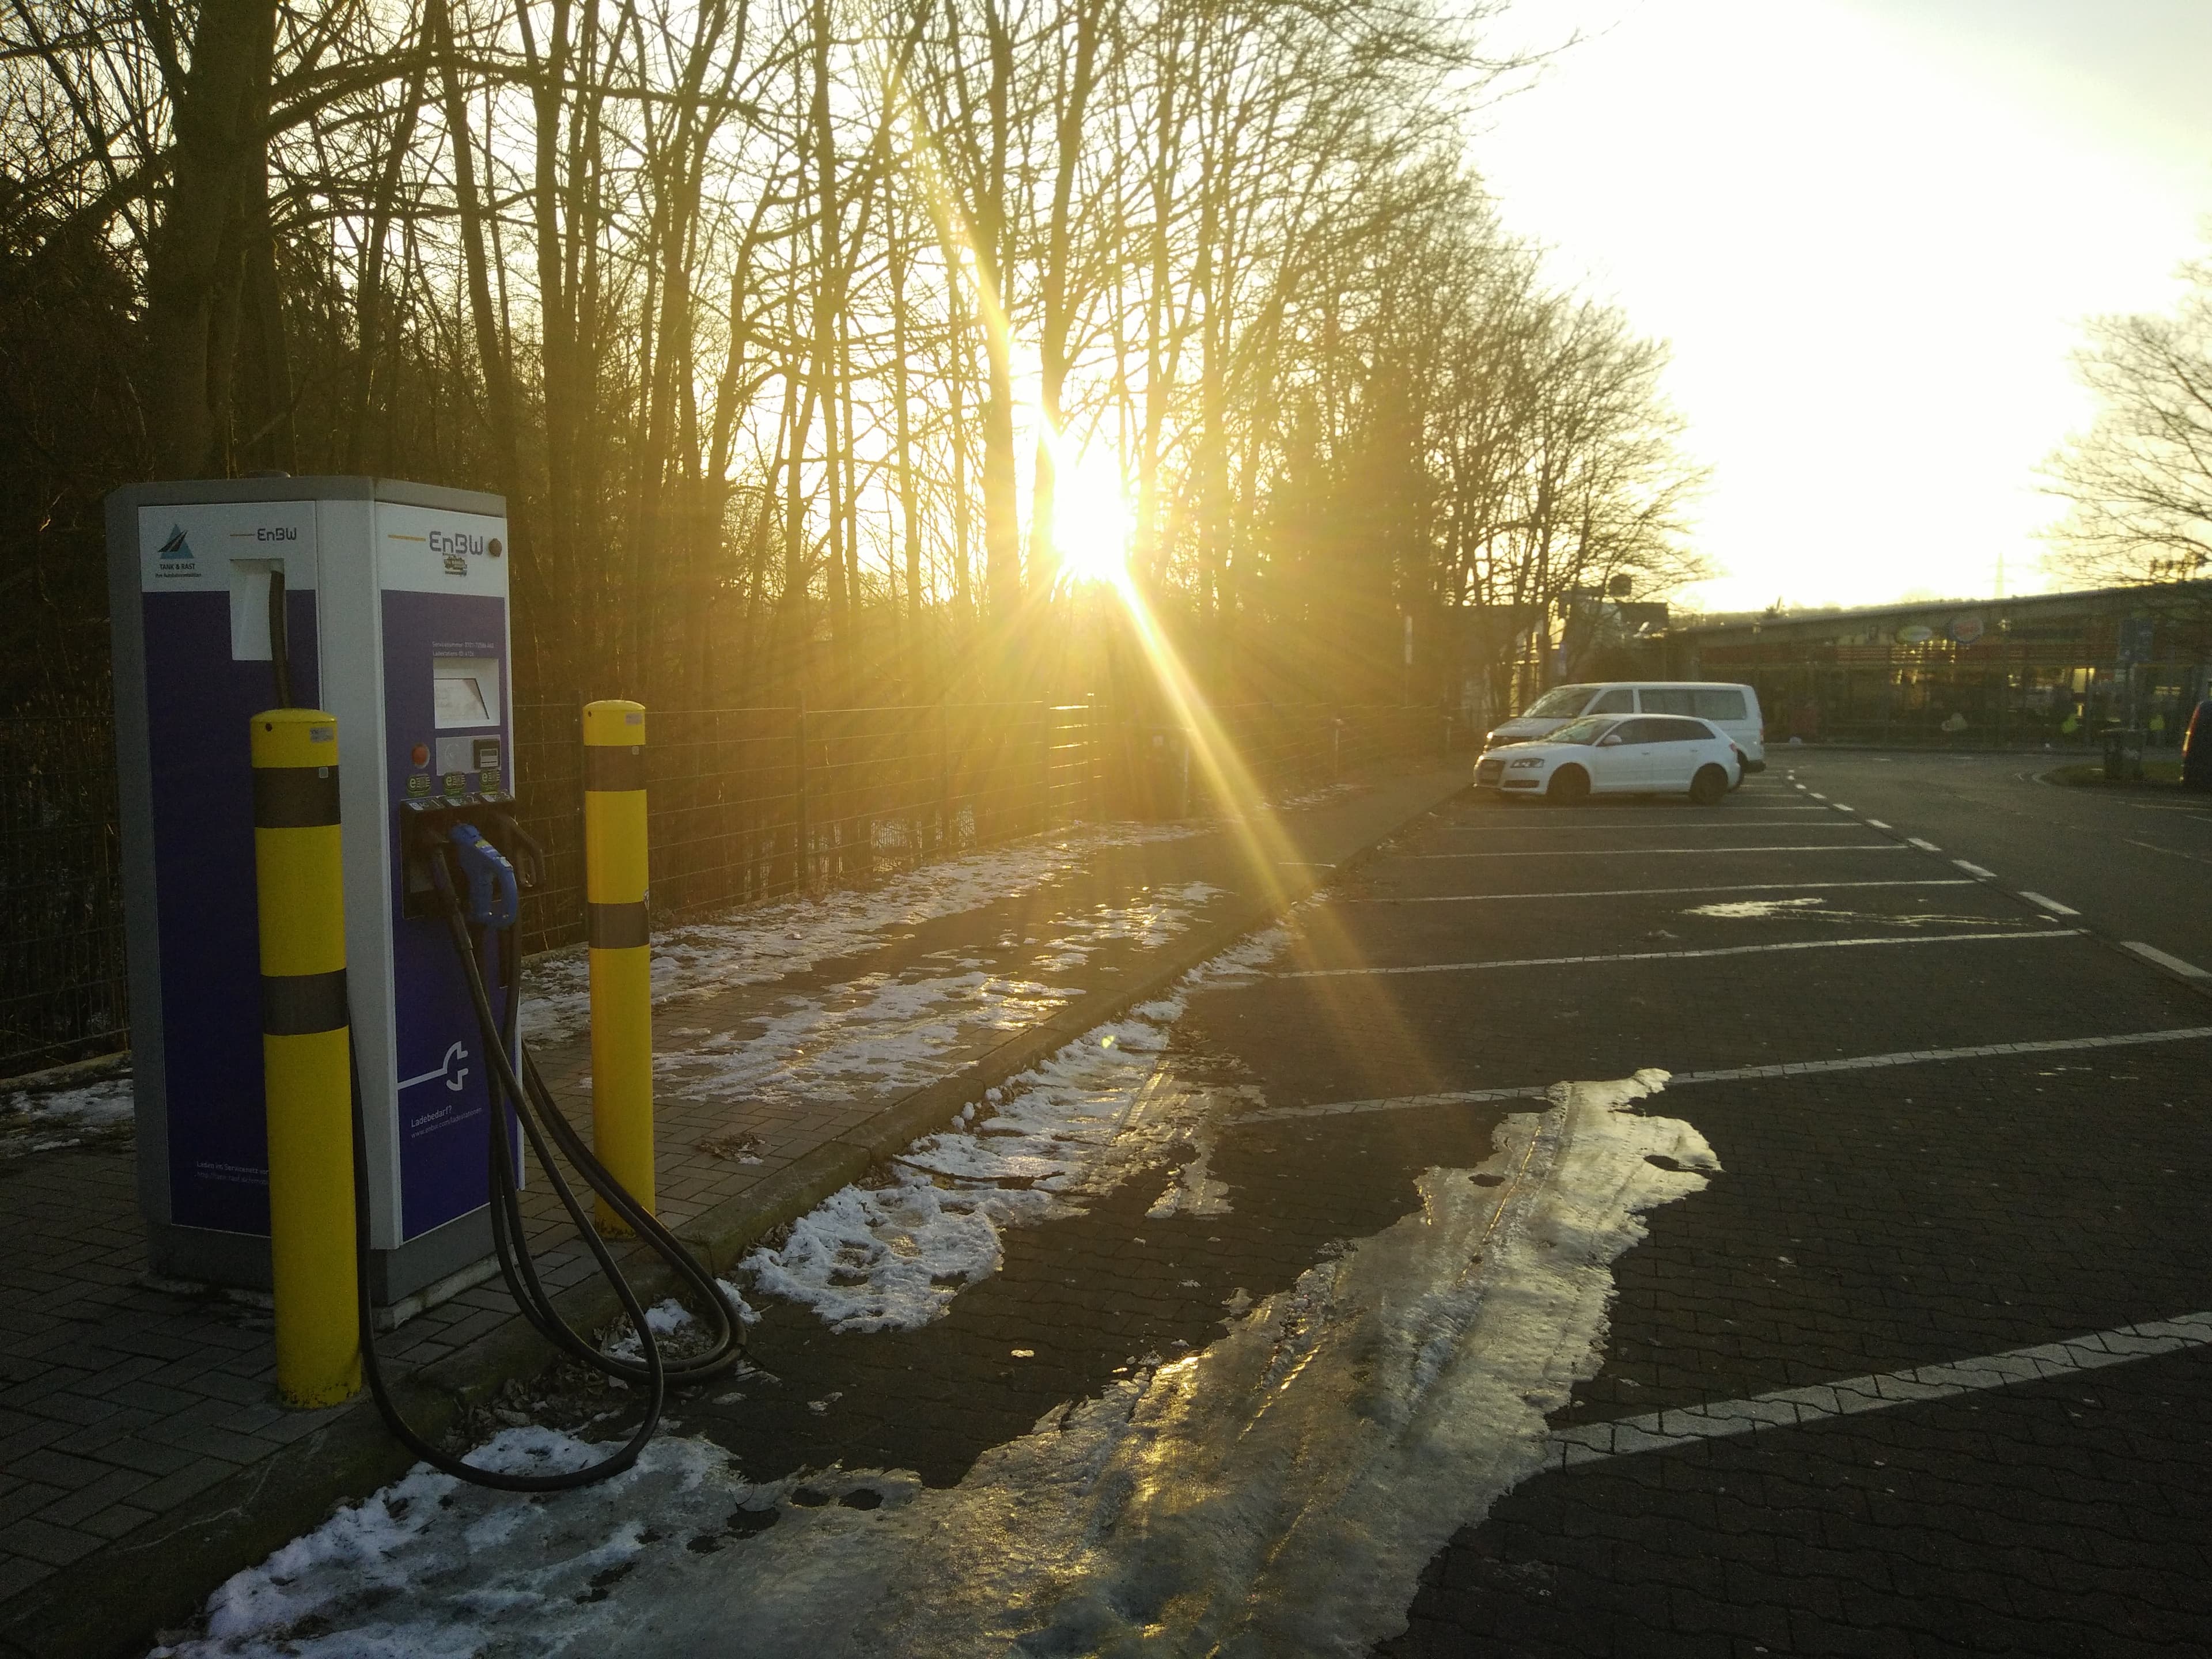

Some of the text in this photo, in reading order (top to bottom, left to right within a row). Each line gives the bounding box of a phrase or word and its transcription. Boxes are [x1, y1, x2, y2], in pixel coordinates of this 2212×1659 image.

[257, 527, 297, 541] EnBW
[429, 531, 483, 555] EnBW
[411, 1105, 452, 1128] Ladebedarf?
